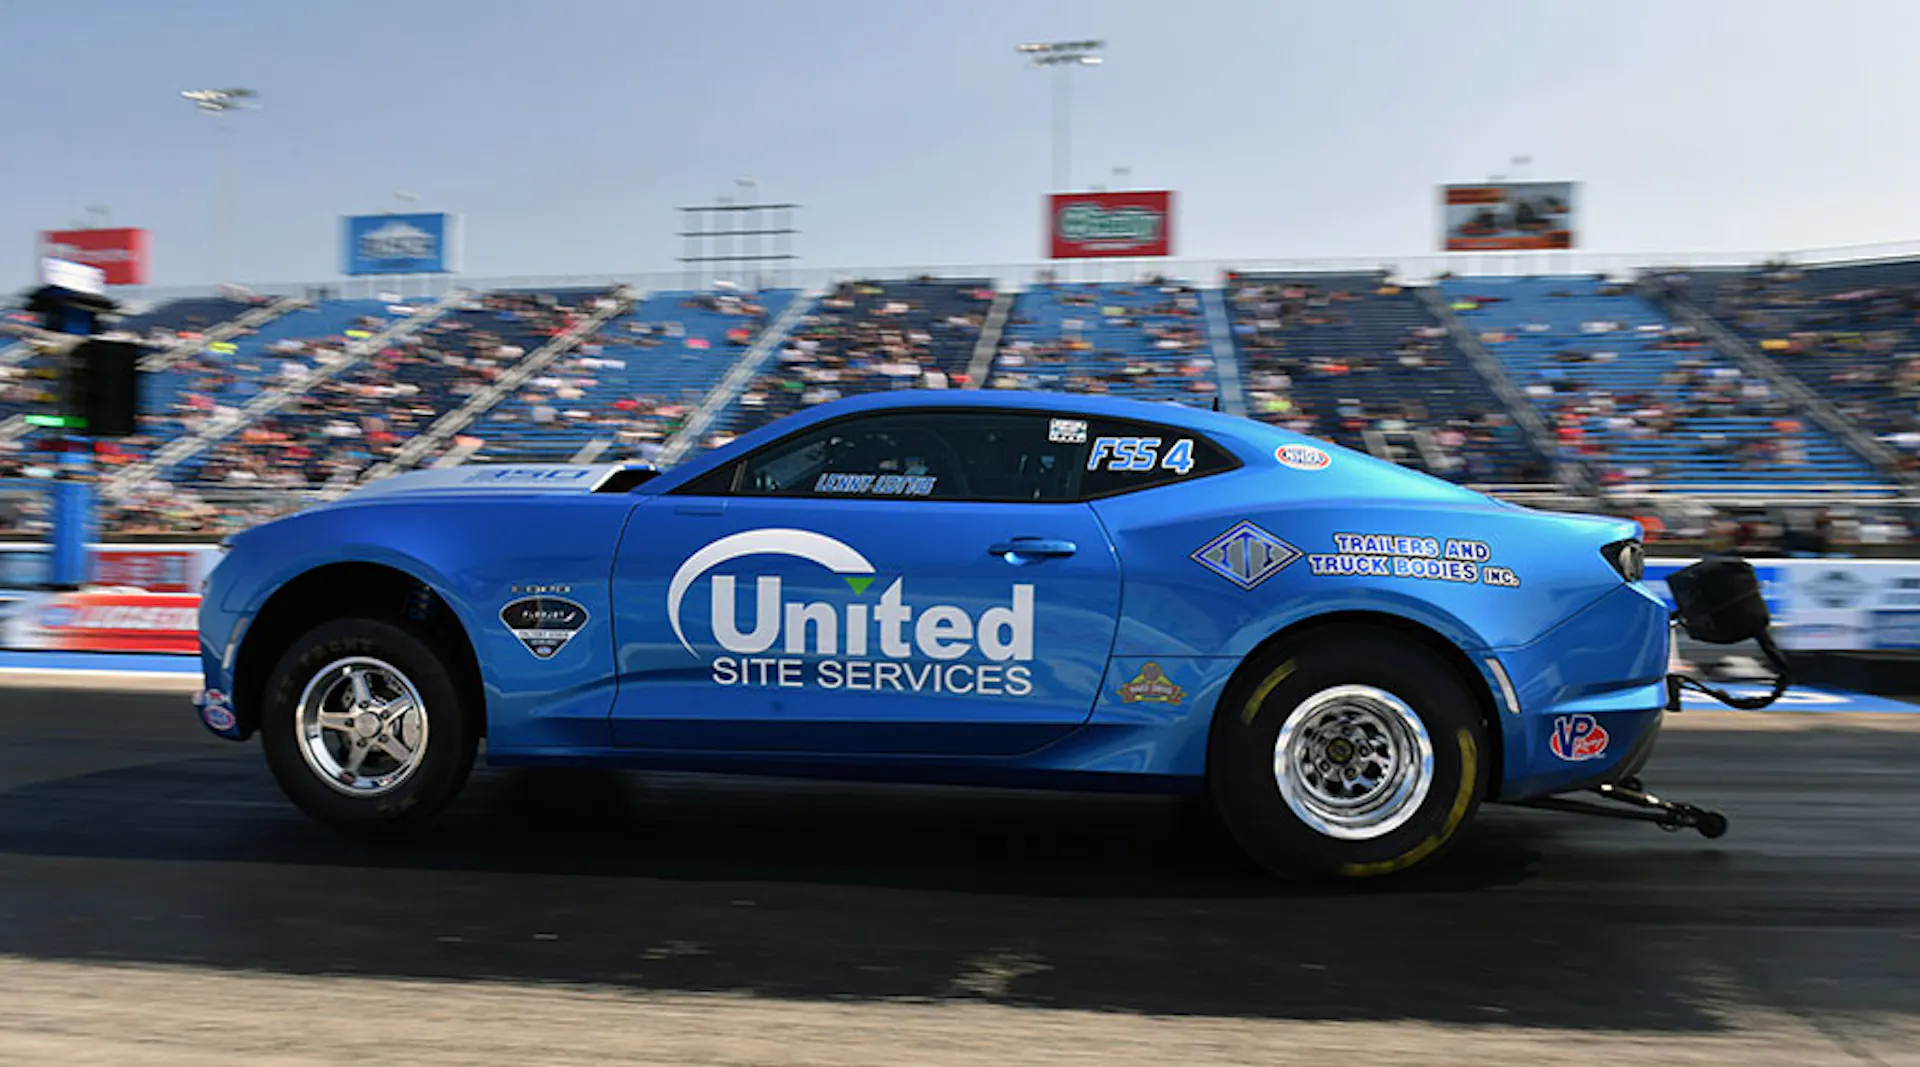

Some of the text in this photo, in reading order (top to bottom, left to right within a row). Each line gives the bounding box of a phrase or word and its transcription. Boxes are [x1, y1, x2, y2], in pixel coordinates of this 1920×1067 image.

[1087, 436, 1195, 475] FSS 4
[1334, 533, 1491, 562] TRAILERS AND
[1308, 554, 1521, 587] TRUCK BODIES INC.
[711, 574, 1035, 661] United
[711, 656, 1033, 696] SITE SERVICES
[1554, 714, 1597, 760] VP
